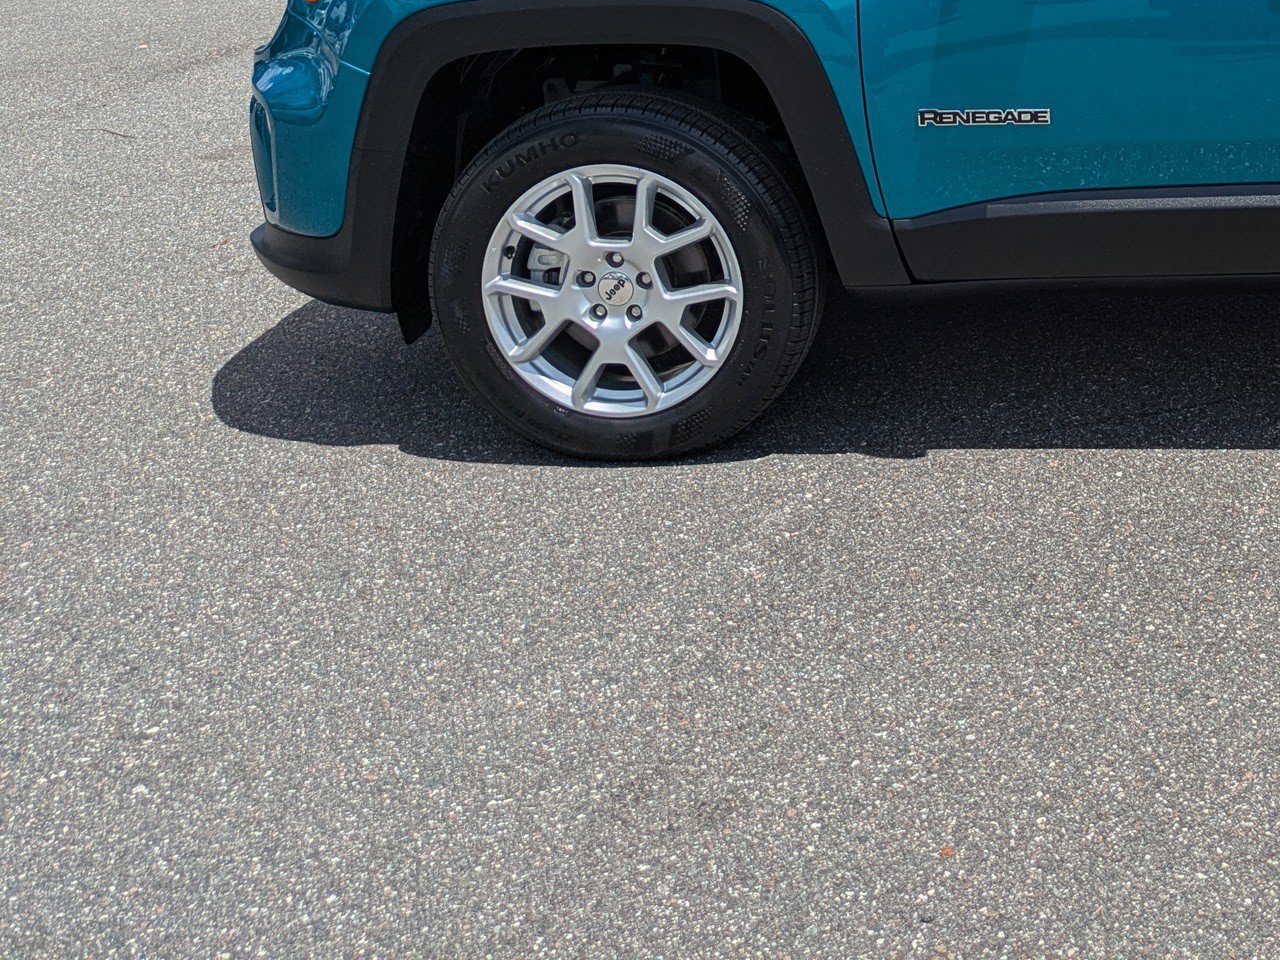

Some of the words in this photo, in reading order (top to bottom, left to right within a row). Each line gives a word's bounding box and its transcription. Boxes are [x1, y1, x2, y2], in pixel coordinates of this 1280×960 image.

[917, 108, 1051, 127] RENEGADE
[480, 133, 579, 194] KUMHO
[604, 278, 626, 301] Jeep
